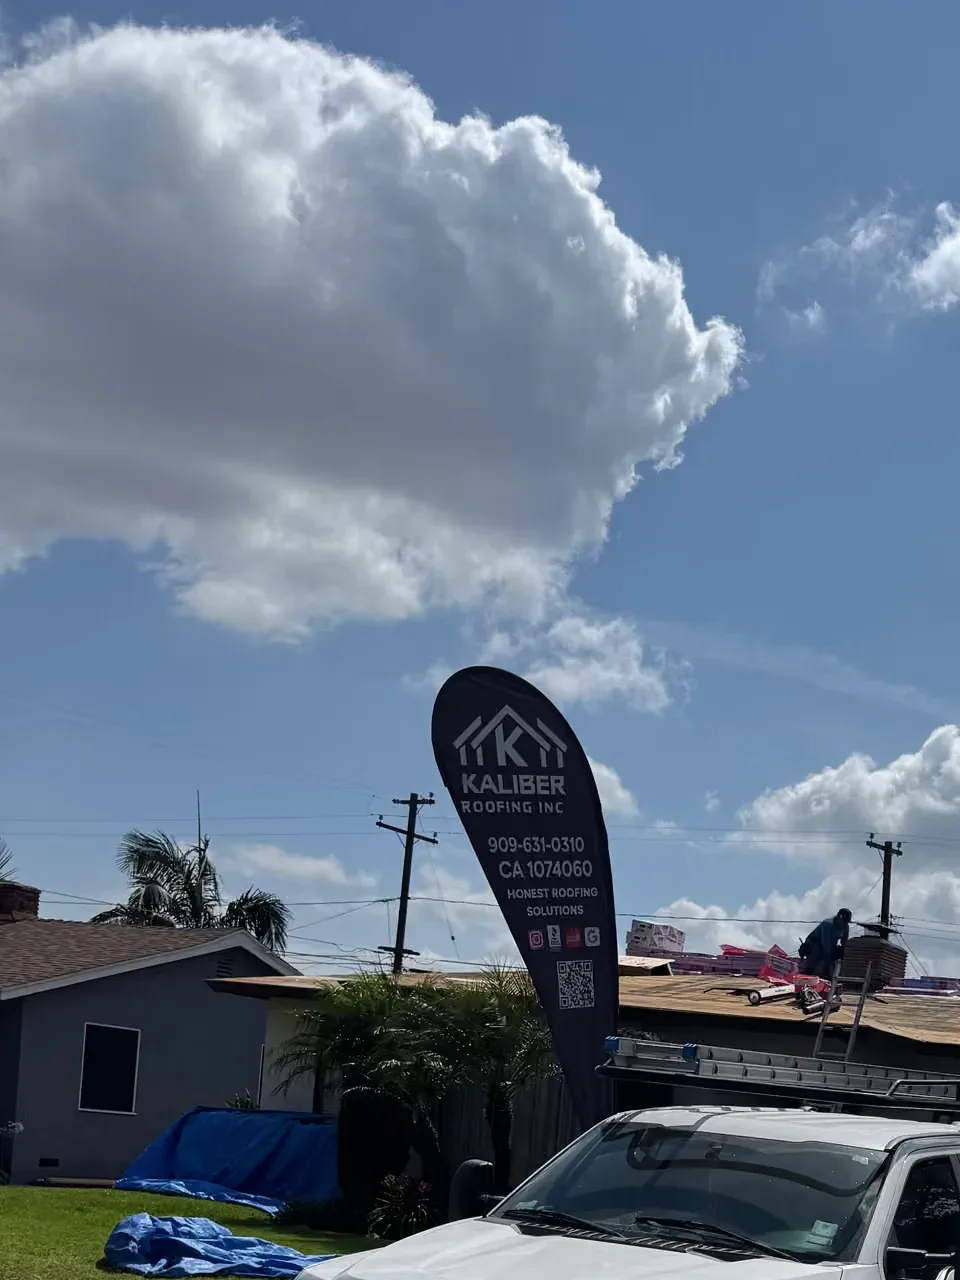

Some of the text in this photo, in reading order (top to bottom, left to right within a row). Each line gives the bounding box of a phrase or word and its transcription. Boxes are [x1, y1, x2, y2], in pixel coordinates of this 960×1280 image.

[461, 773, 566, 795] KALIBER
[461, 800, 563, 814] ROOFING INC
[488, 836, 585, 853] 909-631-0310
[499, 860, 593, 878] CA 1074060
[507, 886, 599, 899] HONEST ROOFING
[526, 904, 584, 916] SOLUTIONS
